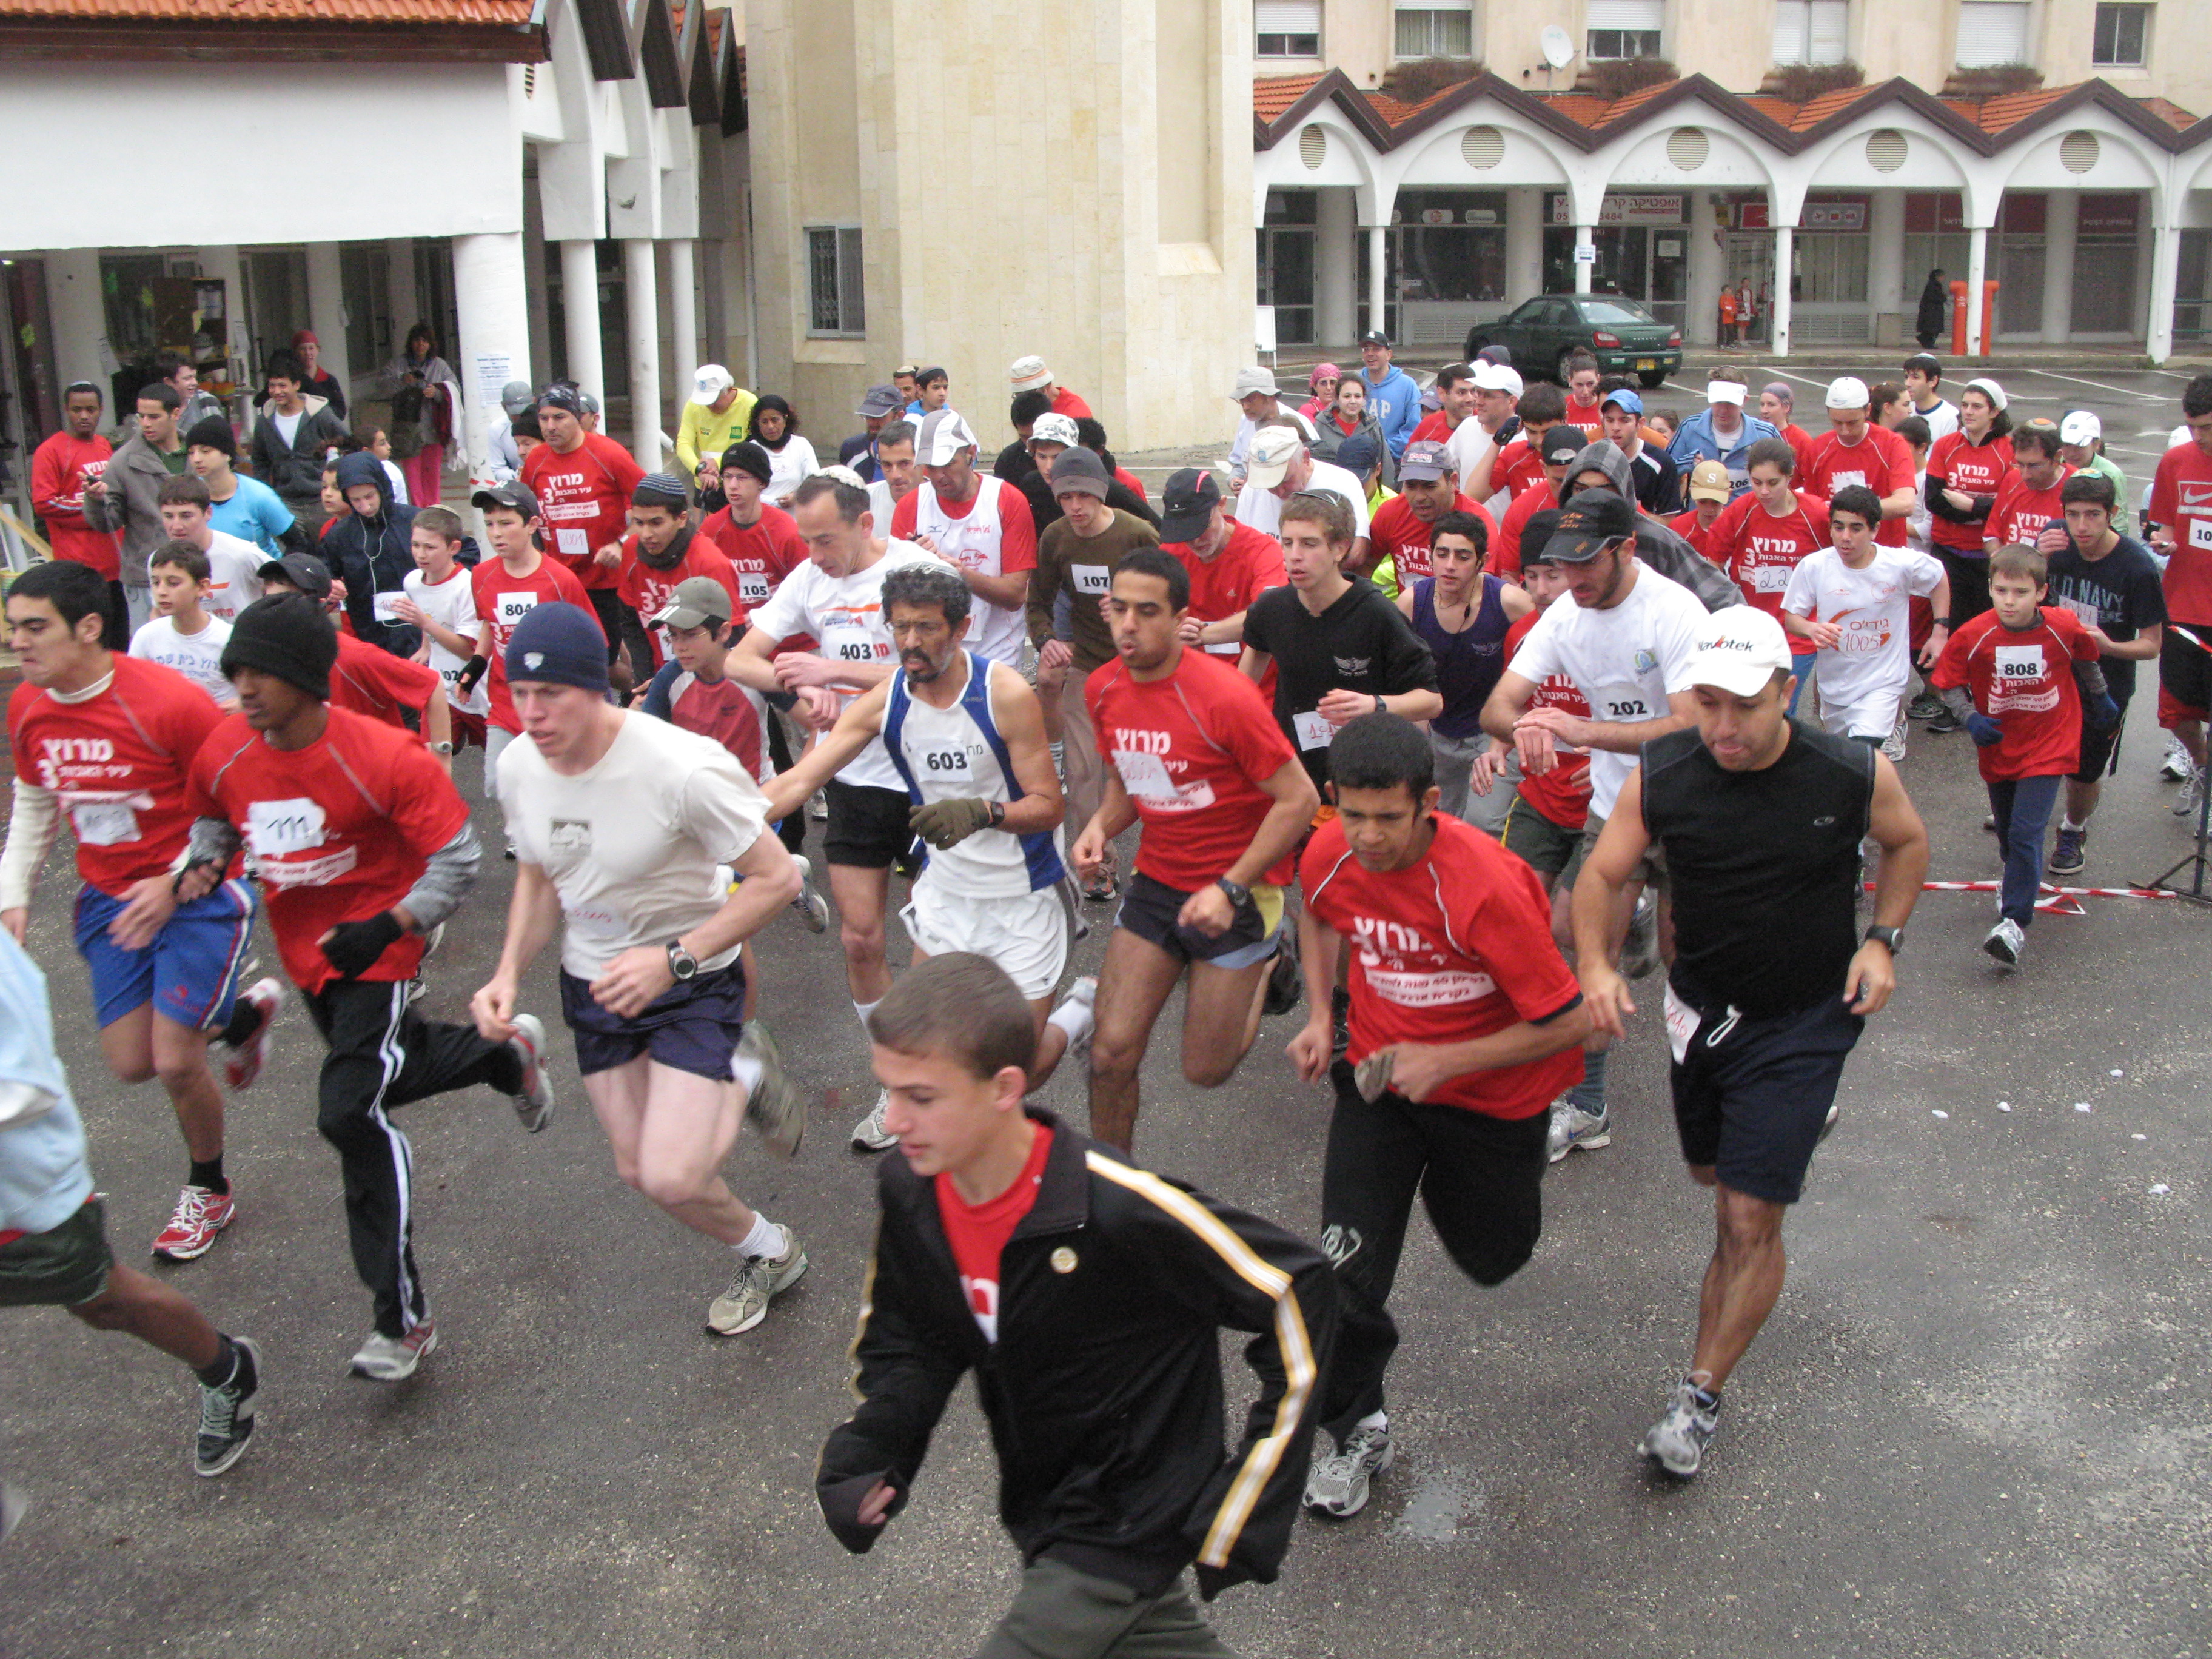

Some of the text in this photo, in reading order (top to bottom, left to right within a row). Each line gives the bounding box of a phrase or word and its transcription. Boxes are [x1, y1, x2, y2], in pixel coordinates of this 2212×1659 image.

[1629, 198, 1680, 209] אופטיקה
[1369, 398, 1392, 418] AP
[1707, 473, 1717, 483] S
[1957, 463, 1989, 477] מרוץ
[548, 473, 583, 491] מרוץ
[1948, 472, 1957, 488] 3
[543, 488, 554, 504] 3
[555, 488, 577, 497] האבות
[2016, 512, 2052, 529] מרוץ
[2008, 524, 2018, 541] 3
[1752, 536, 1797, 554] מרוץ
[1396, 554, 1406, 573] 3
[1744, 548, 1755, 566] 3
[729, 558, 765, 574] מרוץ
[1083, 576, 1108, 587] 107
[743, 585, 768, 596] 105
[2079, 578, 2125, 612] NAVY
[506, 604, 532, 616] 804
[641, 592, 655, 612] 3
[490, 622, 503, 641] 3
[1843, 632, 1879, 651] 1005
[840, 643, 872, 660] 403
[2004, 663, 2038, 675] 808
[2005, 679, 2039, 688] האבות
[1542, 690, 1570, 701] האבות
[1607, 700, 1648, 716] 202
[1115, 728, 1171, 755] מרוץ
[41, 738, 114, 766] מרוץ
[927, 752, 968, 770] 603
[36, 758, 59, 790] 3
[267, 816, 307, 840] 111
